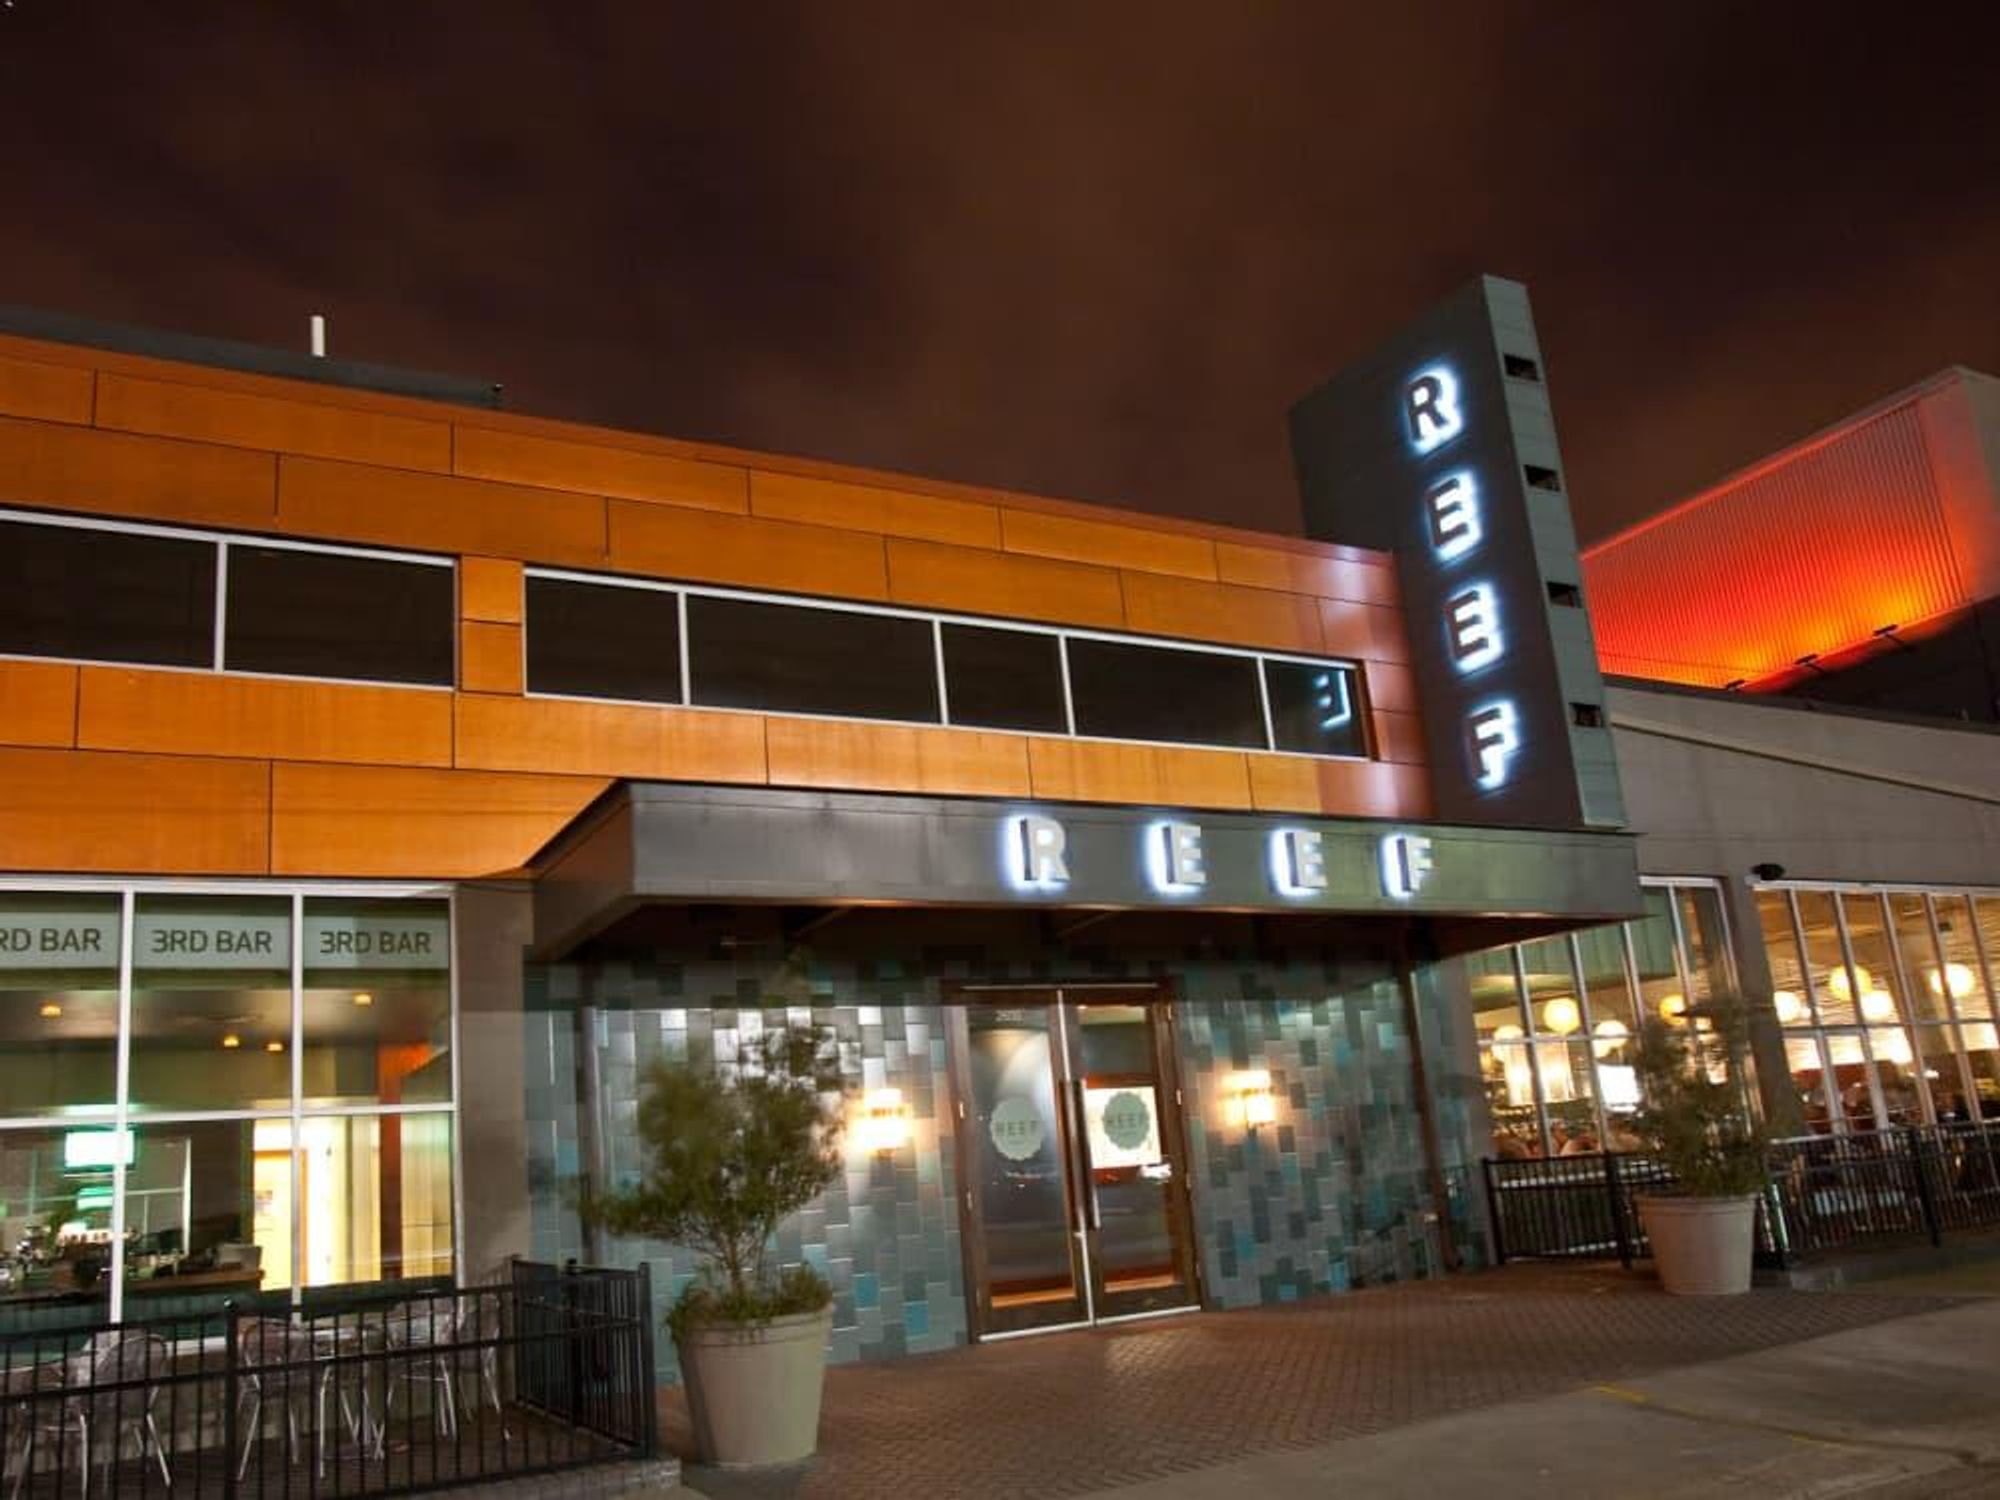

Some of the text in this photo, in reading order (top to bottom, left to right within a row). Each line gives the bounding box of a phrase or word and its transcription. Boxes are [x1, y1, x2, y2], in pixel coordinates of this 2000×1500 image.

[1405, 369, 1514, 787] REEF
[1010, 816, 1433, 893] REEF
[40, 928, 101, 951] BAR
[152, 929, 272, 953] 3RD BAR
[320, 931, 432, 953] 3RD BAR
